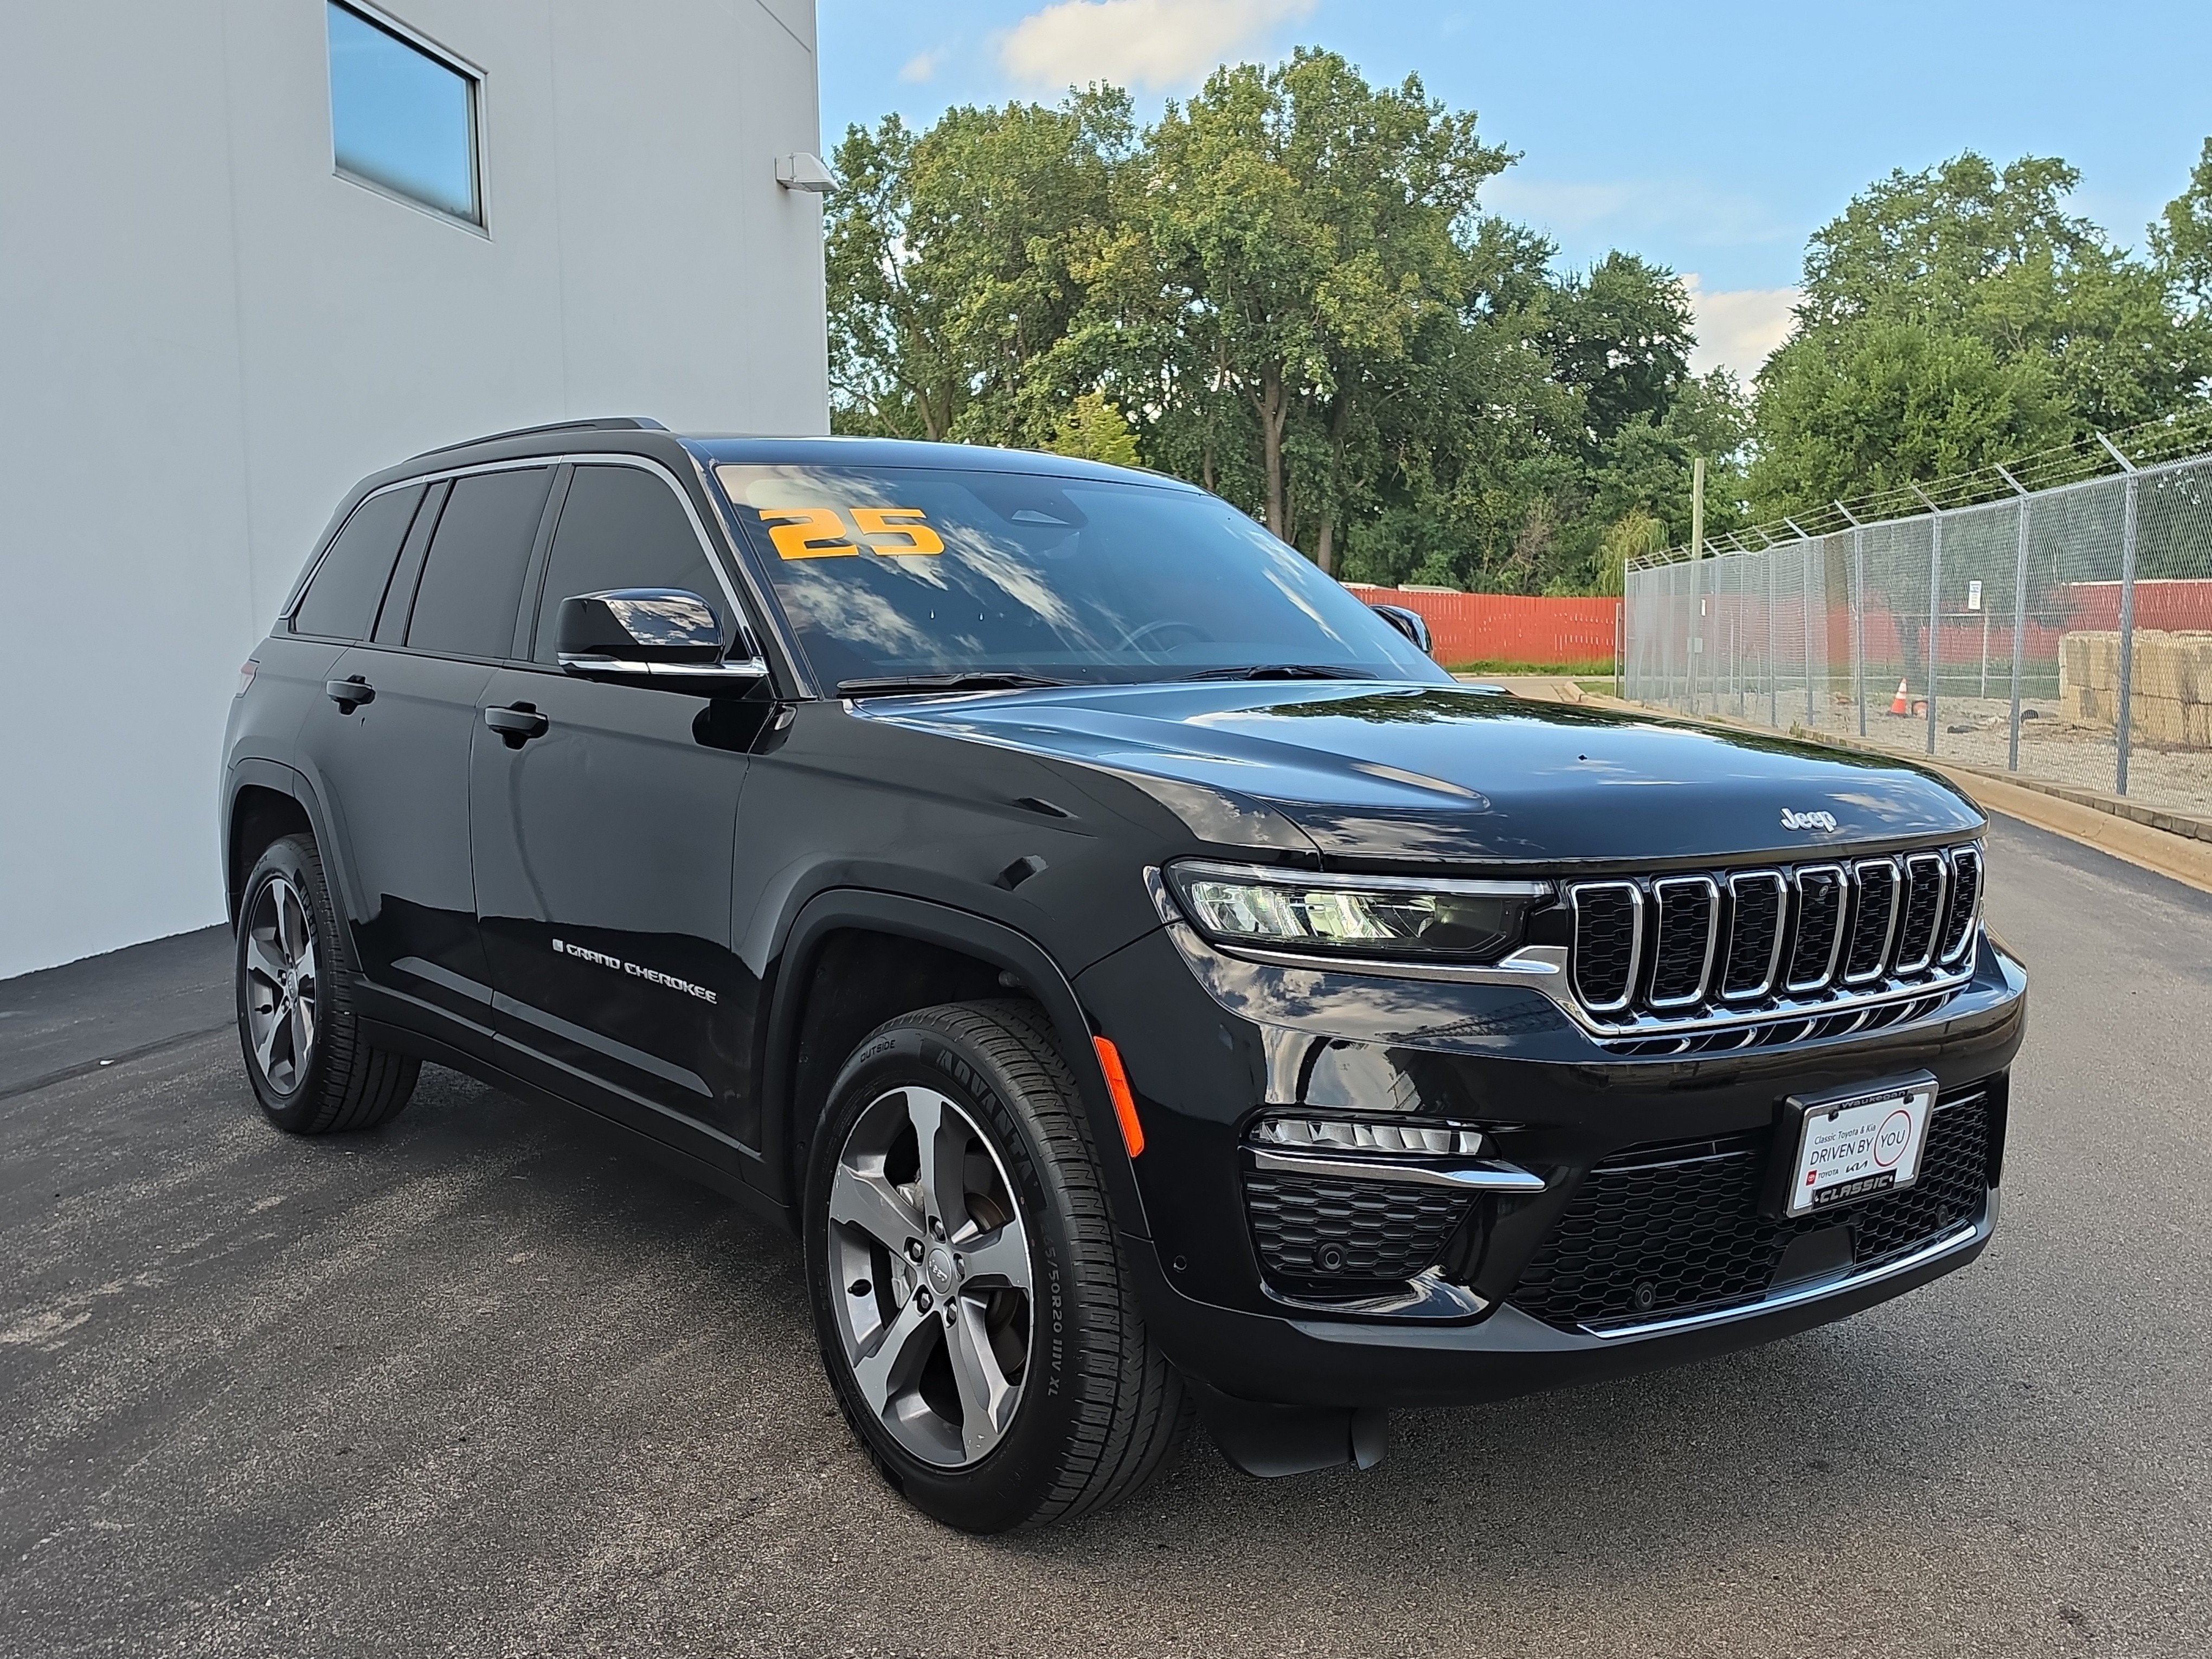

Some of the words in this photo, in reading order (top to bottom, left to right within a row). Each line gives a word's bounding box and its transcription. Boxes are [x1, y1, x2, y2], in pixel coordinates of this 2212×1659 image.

[759, 508, 945, 560] 25
[1779, 808, 1837, 832] Jeep
[566, 944, 620, 969] GRAND
[624, 962, 717, 1004] CHEROKEE
[860, 1040, 896, 1063] OUTSIDE
[1842, 1090, 1906, 1109] Waukegan
[936, 1049, 1033, 1182] ADVANTA
[1814, 1133, 1836, 1145] Classic
[1838, 1129, 1859, 1140] Toyota
[1866, 1124, 1876, 1132] Kia
[1810, 1142, 1856, 1165] DRIVEN
[1857, 1137, 1874, 1154] BY
[1880, 1130, 1906, 1148] YOU
[1818, 1169, 1839, 1180] TOYOTA
[1820, 1175, 1889, 1203] CLASSIC
[1047, 1375, 1060, 1397] XL
